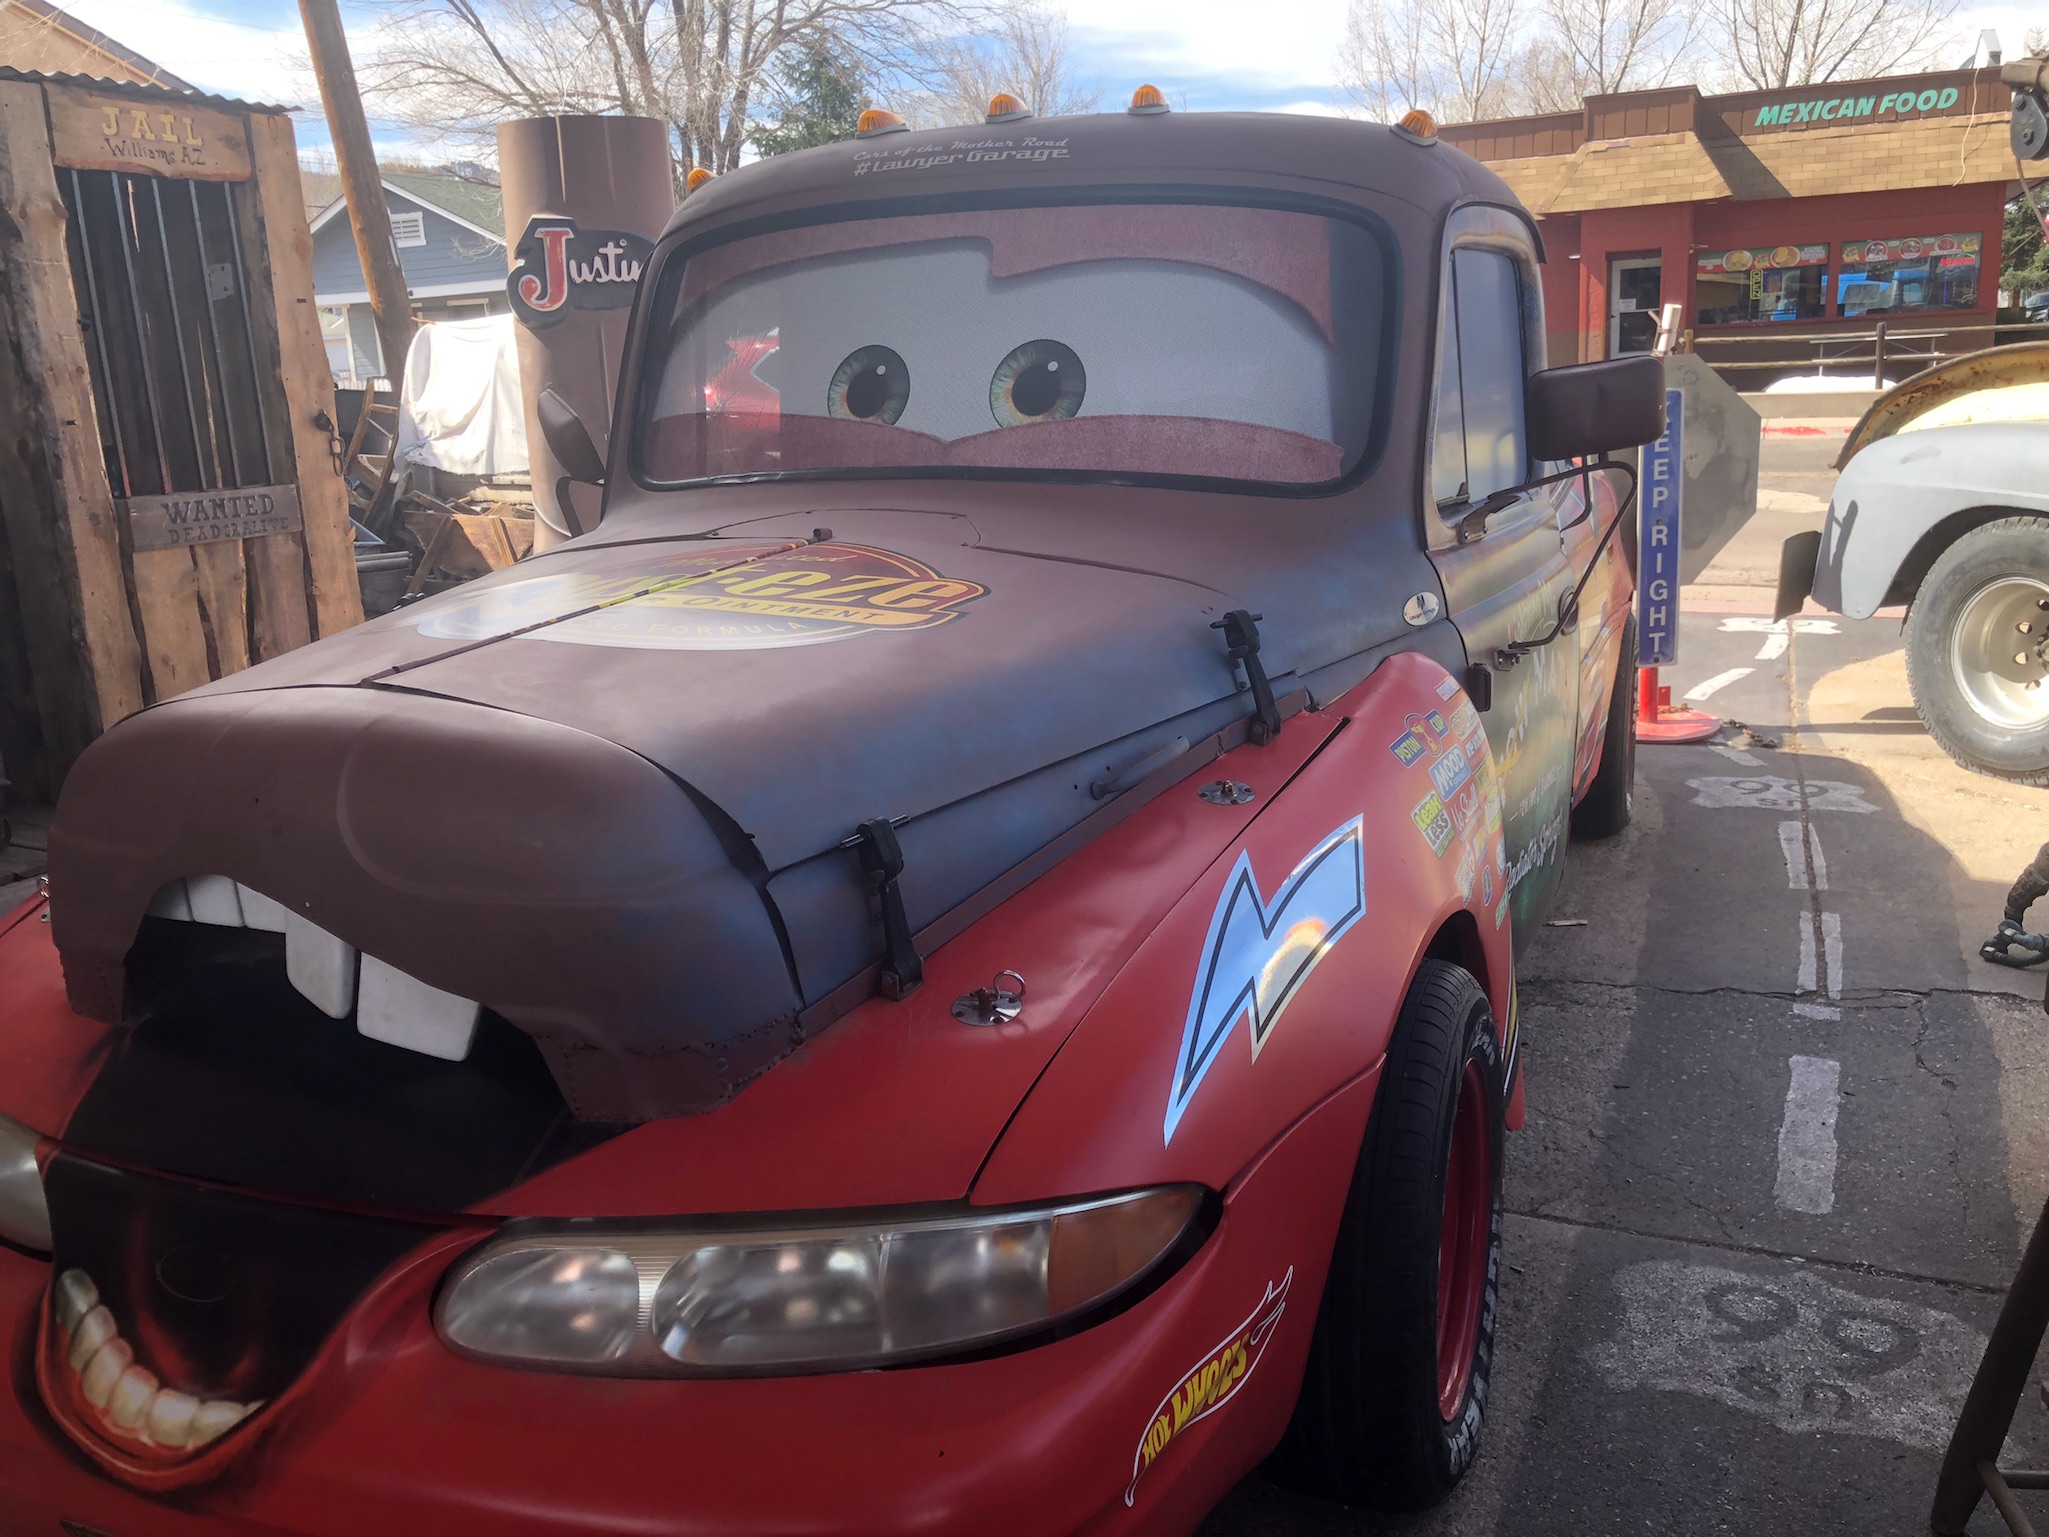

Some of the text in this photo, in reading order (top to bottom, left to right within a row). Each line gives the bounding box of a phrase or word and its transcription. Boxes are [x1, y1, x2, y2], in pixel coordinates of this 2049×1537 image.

[1754, 87, 1959, 127] MEXICAN FOOD
[101, 106, 203, 146] JAIL
[104, 137, 206, 166] Williams AZ
[914, 143, 944, 154] the
[950, 140, 1015, 151] Mother
[1022, 136, 1070, 148] Road
[1751, 270, 1761, 298] OPEN
[160, 493, 275, 525] WANTED
[167, 523, 221, 546] DEAD
[1649, 525, 1669, 654] RIGHT
[649, 621, 806, 635] FORMULA
[1394, 735, 1422, 763] PISTON
[1429, 714, 1445, 733] CUP
